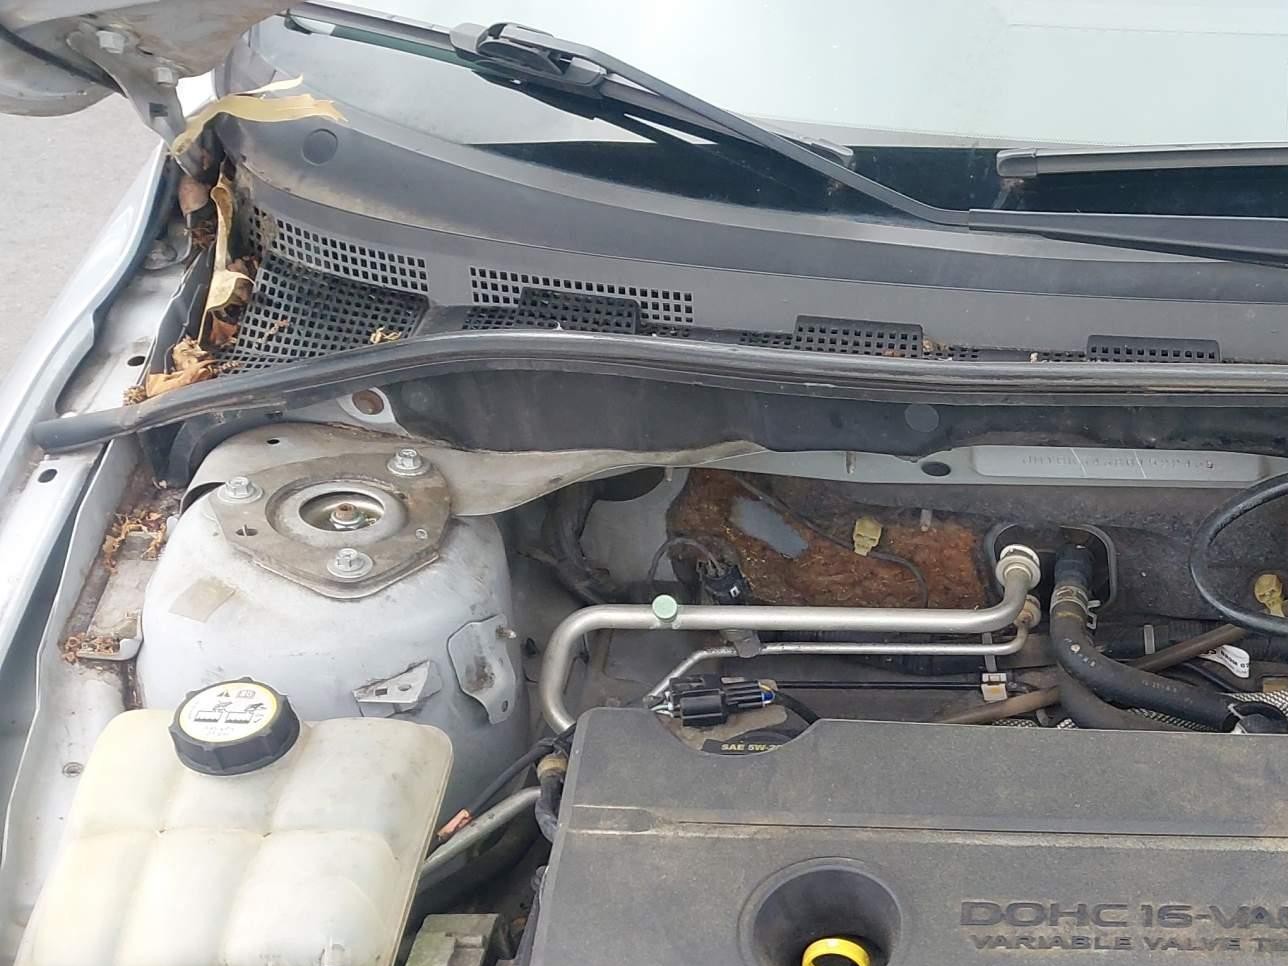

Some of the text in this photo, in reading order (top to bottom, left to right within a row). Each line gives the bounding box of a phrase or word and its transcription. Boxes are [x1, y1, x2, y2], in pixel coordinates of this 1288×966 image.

[960, 901, 1128, 928] DOHC
[971, 934, 1131, 950] VARIABLE
[1144, 936, 1241, 951] VALVE
